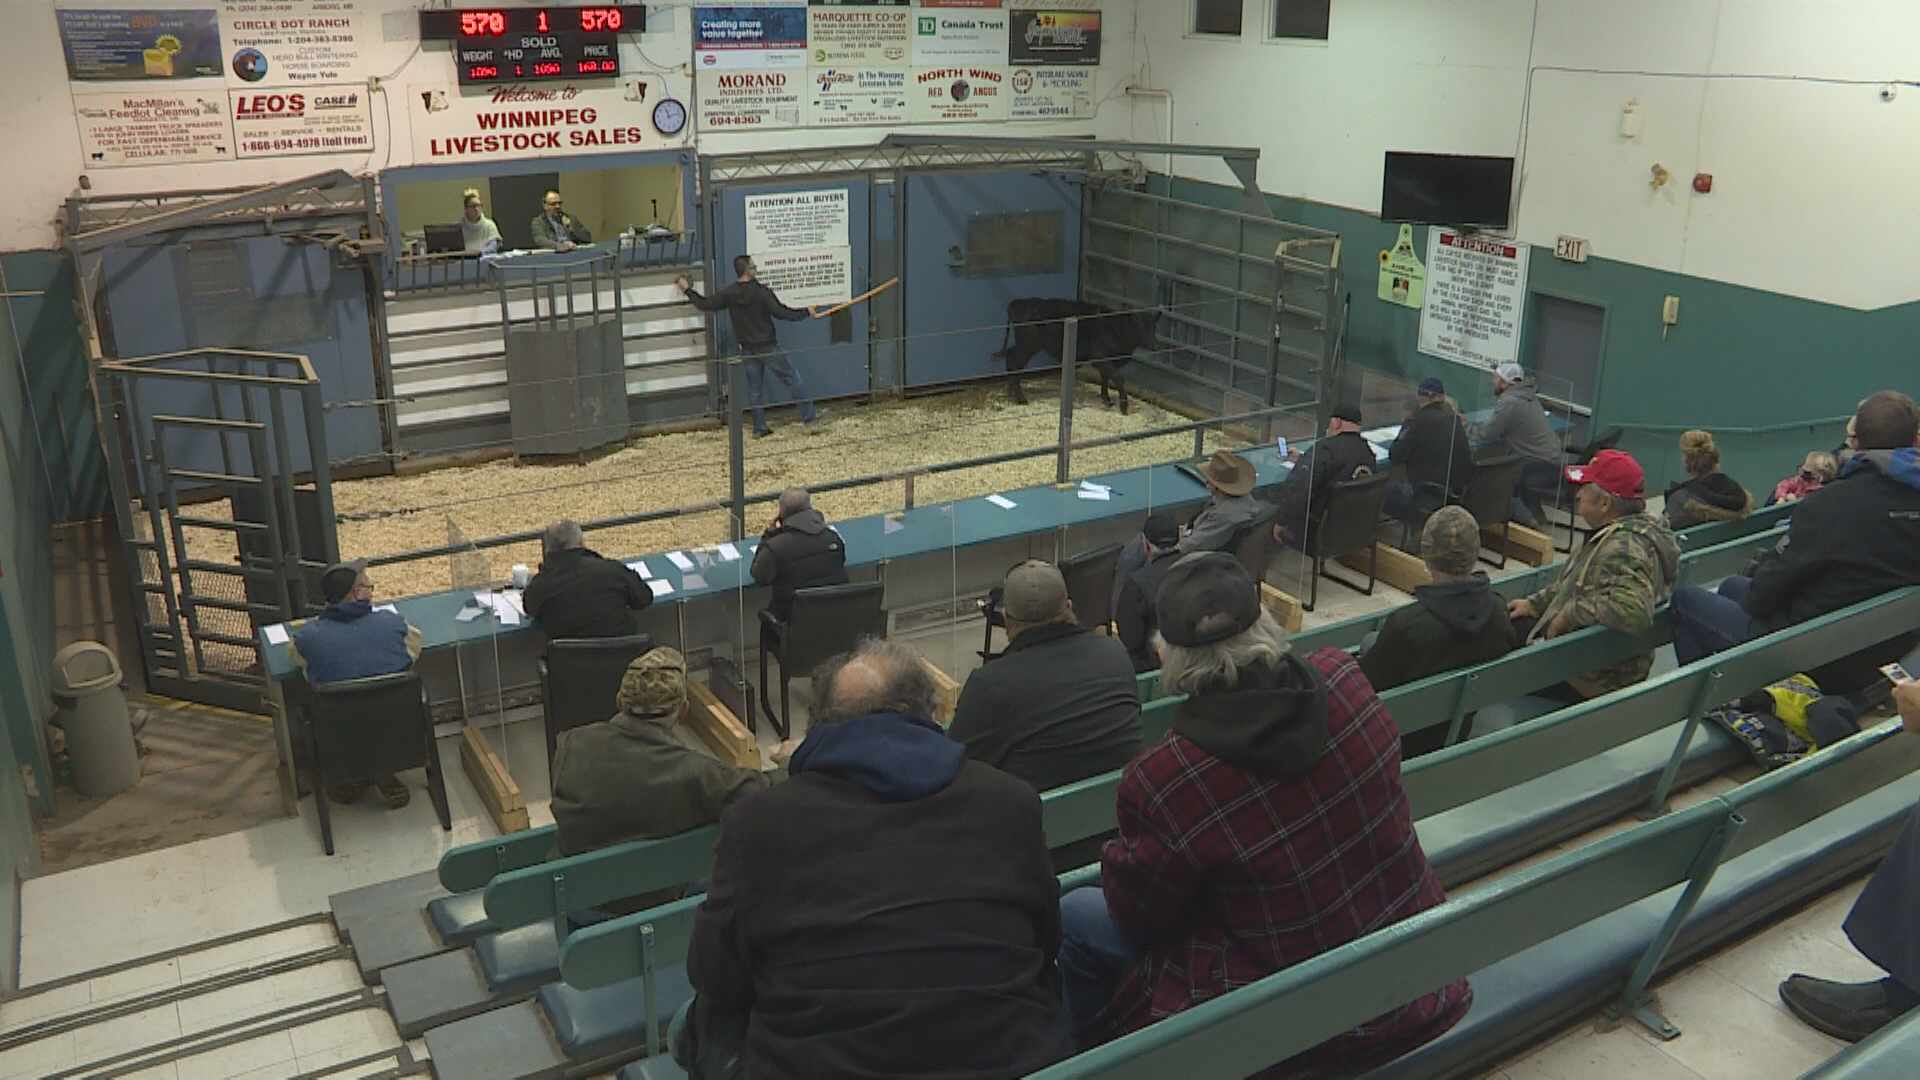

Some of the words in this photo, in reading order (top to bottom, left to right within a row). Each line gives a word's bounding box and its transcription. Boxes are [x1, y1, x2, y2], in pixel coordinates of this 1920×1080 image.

[131, 15, 158, 28] BVD
[462, 12, 505, 35] 570
[538, 11, 548, 31] 1
[582, 10, 621, 31] 570
[813, 13, 873, 22] MARQUETTE
[875, 13, 907, 21] CO-OP
[233, 20, 277, 30] CIRCLE
[281, 20, 304, 29] DOT
[308, 18, 350, 28] RANCH
[739, 21, 761, 29] more
[920, 20, 935, 33] TD
[941, 20, 976, 29] Canada
[979, 20, 1003, 30] Trust
[702, 30, 726, 38] value
[727, 29, 763, 39] together
[233, 38, 283, 46] Telephone:
[521, 36, 557, 48] SOLD
[316, 51, 358, 60] WINTERING
[462, 51, 494, 62] WEIGHT
[540, 47, 563, 58] AVG.
[584, 45, 609, 56] PRICE
[311, 61, 350, 69] BOARDING
[516, 65, 522, 76] 1
[535, 63, 560, 74] 1090
[288, 72, 317, 81] Wayne
[320, 71, 338, 79] Yule
[718, 73, 787, 88] MORAND
[858, 72, 865, 80] At
[866, 71, 877, 79] The
[878, 71, 905, 80] Winnipeg
[917, 69, 963, 84] NORTH
[969, 69, 1002, 83] WIND
[859, 80, 886, 88] Livestock
[487, 84, 557, 104] Welcome
[561, 83, 581, 100] to
[719, 88, 764, 96] INDUSTRIES
[768, 87, 784, 95] LTD.
[928, 87, 943, 97] RED
[973, 87, 998, 96] ANGUS
[123, 98, 185, 108] MacMillan's
[237, 93, 305, 114] LEO'S
[314, 96, 346, 106] CASE
[704, 98, 730, 106] QUALITY
[766, 95, 798, 103] EQUIPMENT
[109, 108, 151, 119] Feedlot
[154, 107, 200, 118] Cleaning
[477, 108, 597, 130] WINNIPEG
[184, 121, 223, 129] SPREADERS
[281, 128, 314, 136] SERVICE
[326, 125, 362, 133] RENTALS
[140, 136, 190, 144] DEPENDABLE
[192, 133, 223, 141] SERVICE
[343, 135, 367, 145] free)
[430, 131, 560, 156] LIVESTOCK
[570, 127, 642, 147] SALES
[749, 198, 794, 208] ATTENTION
[796, 196, 811, 204] ALL
[813, 193, 845, 203] BUYERS
[1451, 237, 1504, 255] ATTENTION
[1557, 237, 1582, 260] EXIT
[1446, 249, 1461, 258] CATTLE
[1463, 253, 1486, 263] RECEIVED
[1434, 255, 1457, 266] LIVESTOCK
[1460, 260, 1474, 269] SALES
[1486, 265, 1499, 275] MUST
[1501, 269, 1513, 278] HAVE
[1464, 270, 1475, 278] THEY
[1497, 277, 1515, 286] PLEASE
[1458, 303, 1478, 312] WITHOUT
[1472, 297, 1484, 305] EACH
[1485, 300, 1496, 308] AND
[1496, 303, 1512, 312] EVERY
[1453, 317, 1469, 327] CATTLE
[1470, 322, 1489, 332] UNLESS
[1470, 313, 1501, 326] RESPONSIBLE
[1502, 321, 1513, 329] FOR
